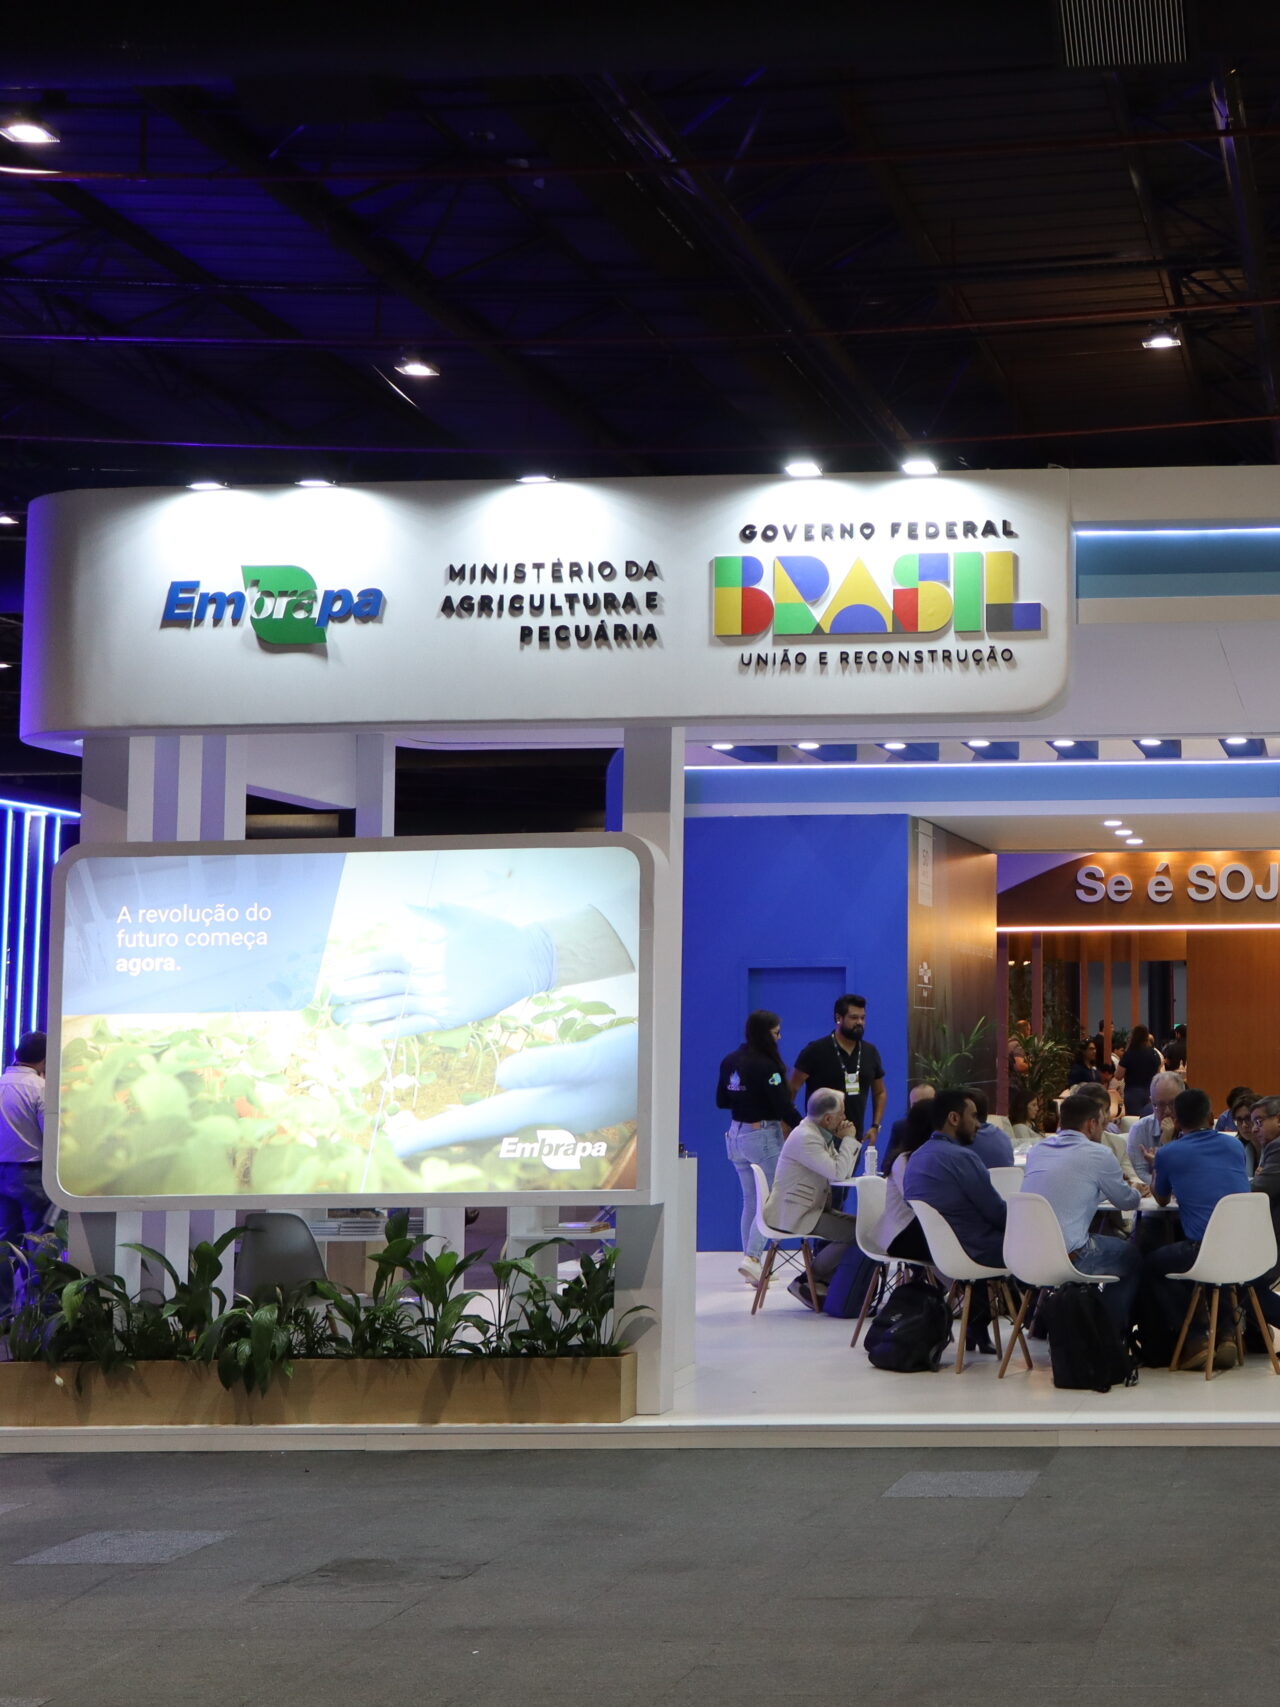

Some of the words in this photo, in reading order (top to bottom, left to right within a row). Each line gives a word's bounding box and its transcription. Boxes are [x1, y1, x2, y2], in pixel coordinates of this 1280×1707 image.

[739, 521, 876, 543] GOVERNO
[890, 519, 1016, 539] FEDERAL
[447, 558, 616, 584] MINISTÉRIO
[624, 560, 659, 582] DA
[161, 579, 386, 628] Embrapa
[440, 592, 639, 617] AGRICULTURA
[645, 591, 659, 610] E
[713, 551, 1042, 635] BRASIL
[519, 620, 658, 645] PECUÁRIA
[740, 648, 807, 667] UNIÃO
[818, 651, 829, 665] E
[839, 646, 1014, 666] RECONSTRUÇÃO
[1075, 865, 1133, 903] Se
[1147, 862, 1174, 903] é
[116, 906, 132, 924] A
[138, 904, 239, 927] revolução
[245, 902, 271, 921] do
[116, 929, 179, 948] futuro
[184, 931, 268, 950] começa
[115, 956, 182, 976] agora.
[499, 1137, 608, 1158] Embrapa
